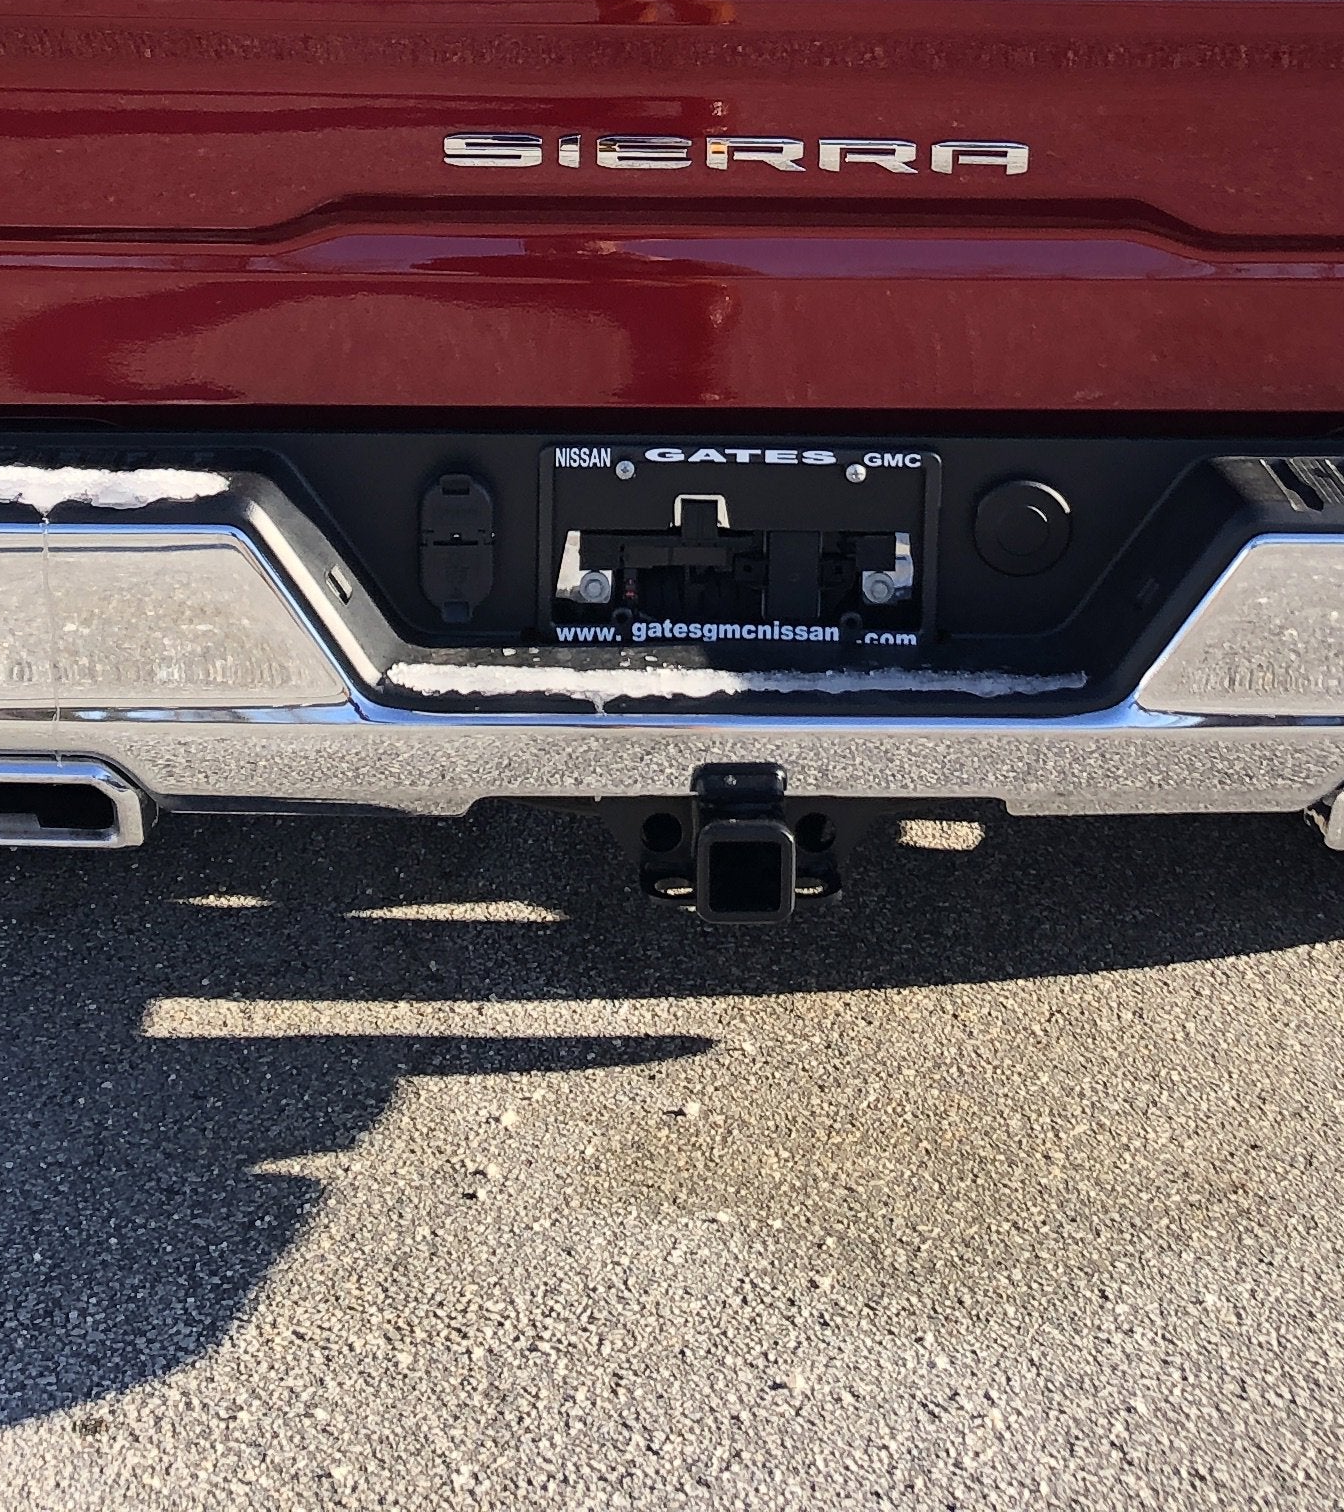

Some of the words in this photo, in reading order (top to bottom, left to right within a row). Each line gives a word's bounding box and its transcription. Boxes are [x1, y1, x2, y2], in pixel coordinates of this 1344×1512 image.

[443, 133, 1030, 175] SIERRA
[555, 448, 611, 468] NISSAN
[644, 448, 837, 465] GATES
[863, 452, 921, 468] GMC
